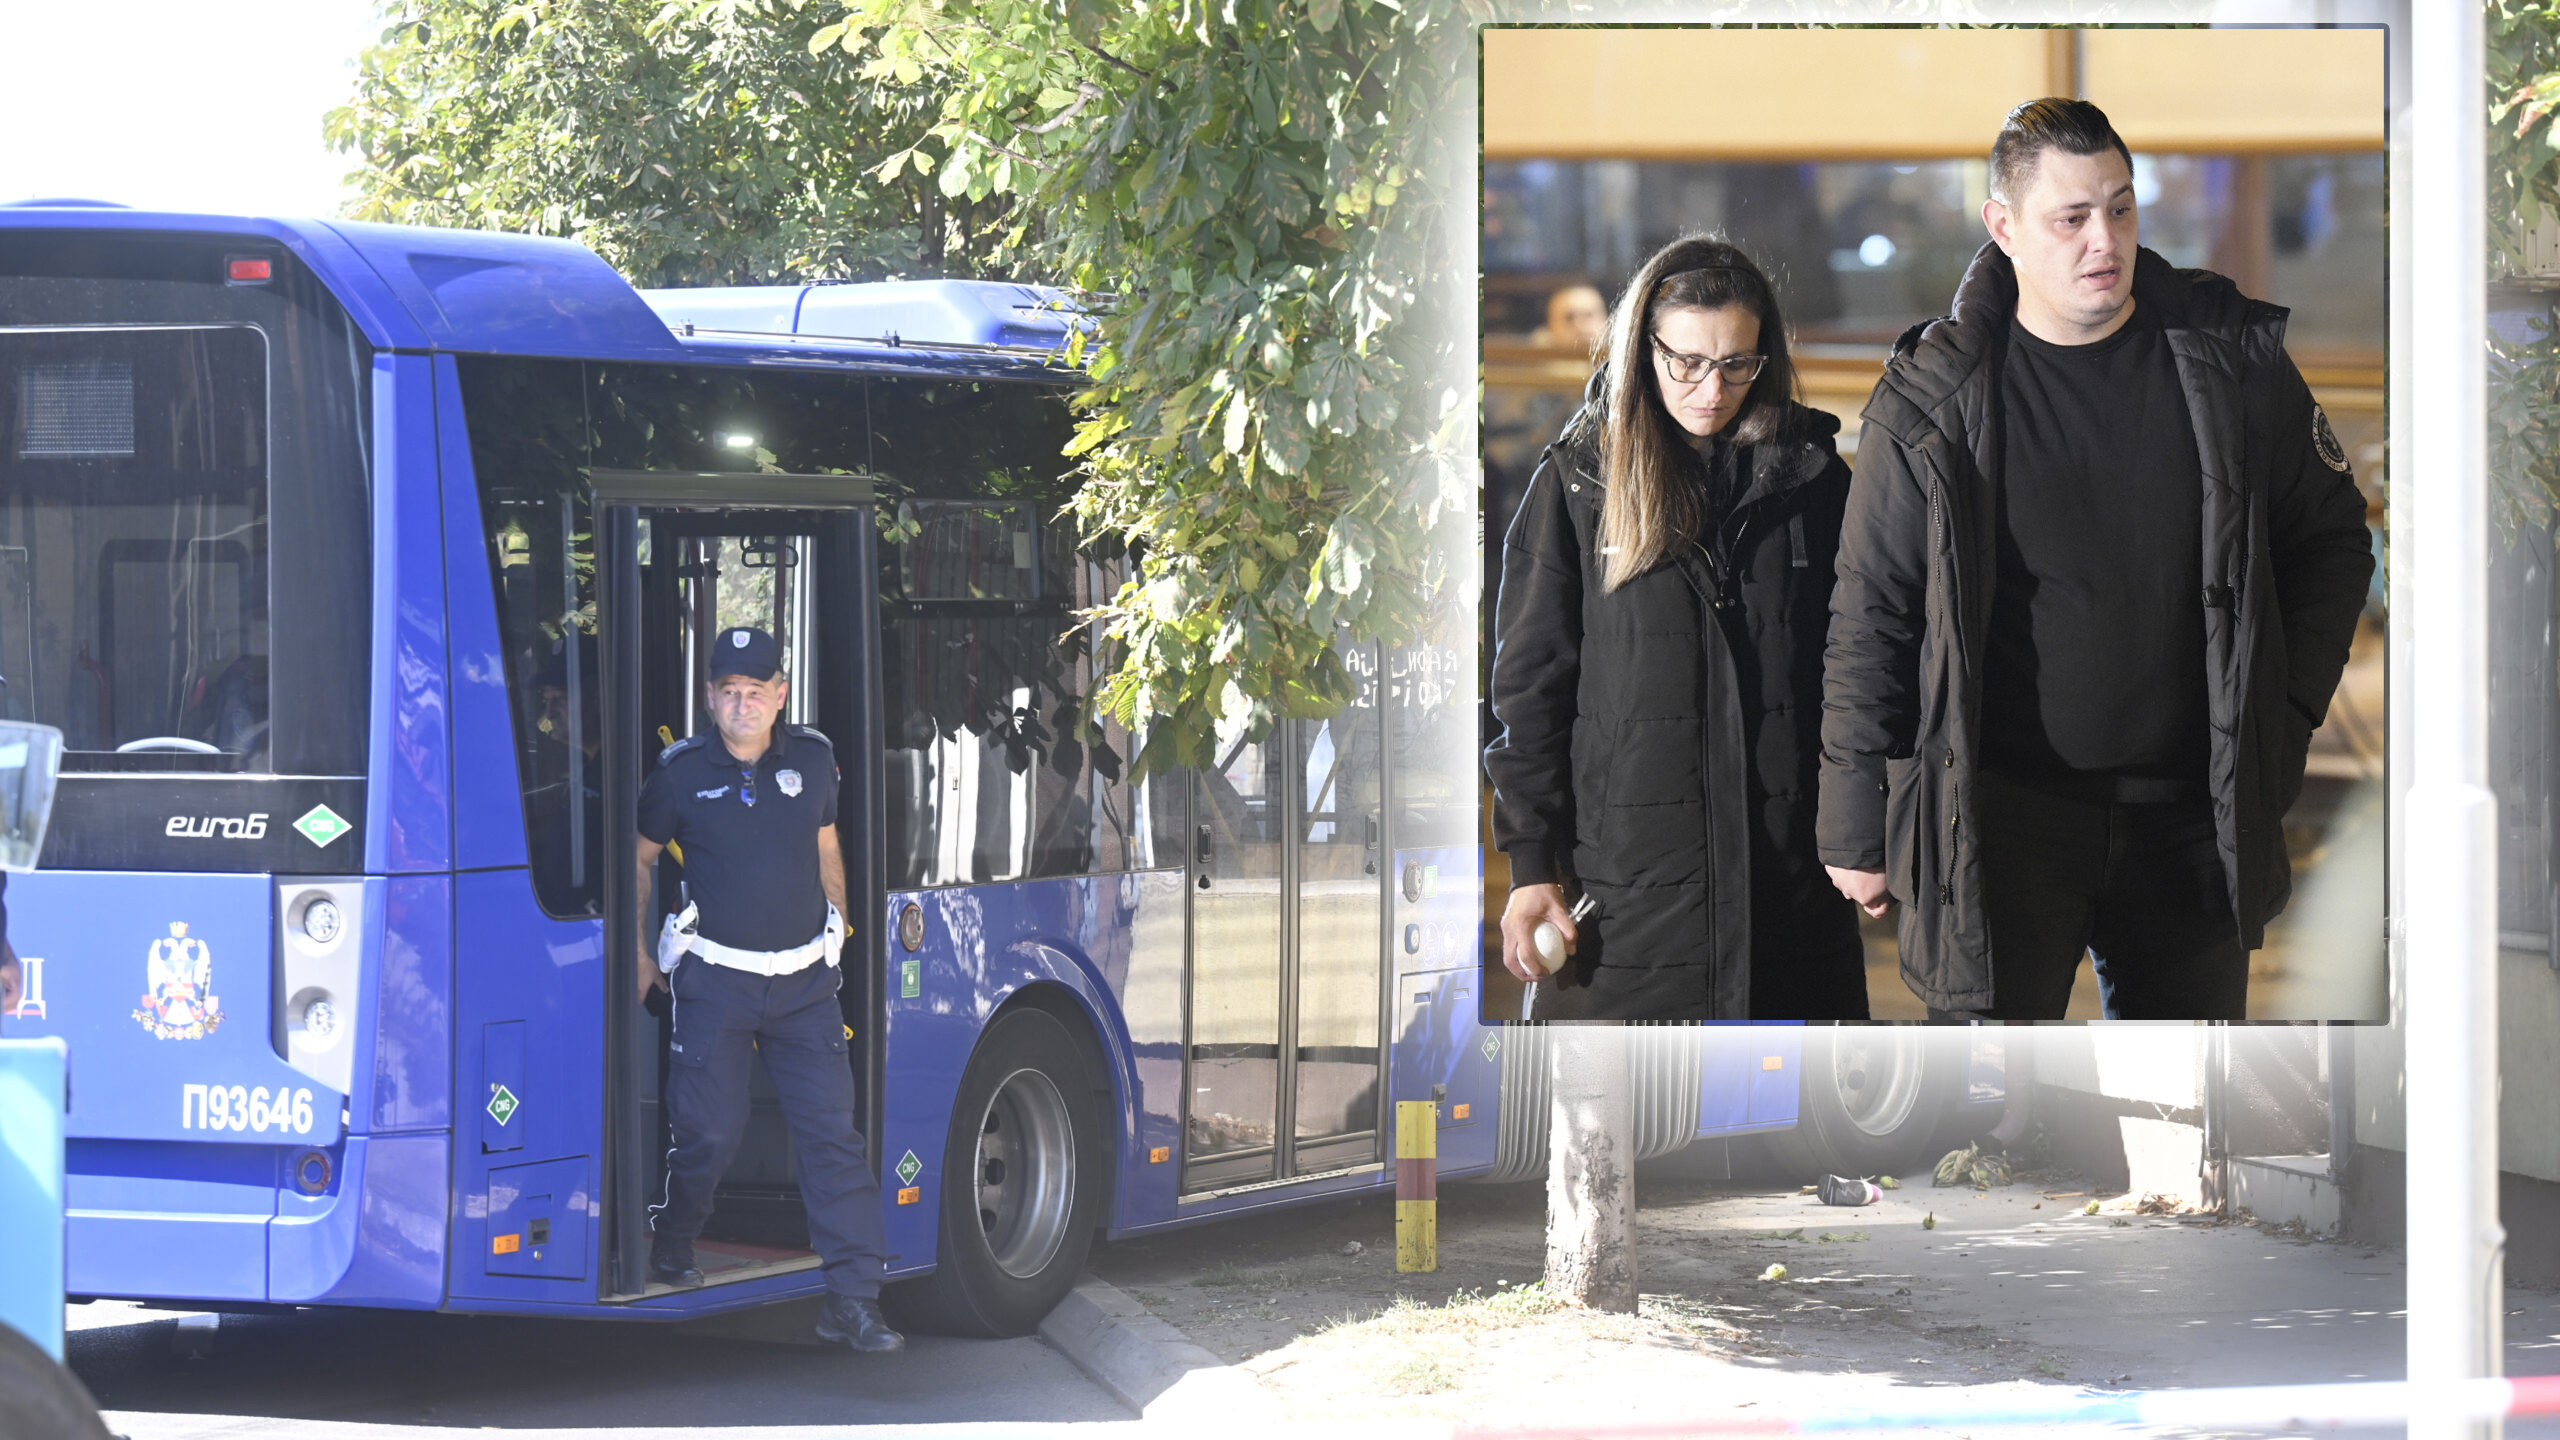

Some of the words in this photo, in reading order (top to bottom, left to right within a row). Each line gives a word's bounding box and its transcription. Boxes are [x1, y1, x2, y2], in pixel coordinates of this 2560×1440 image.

[182, 1083, 314, 1134] П93646
[495, 1098, 510, 1113] CNG
[902, 1161, 915, 1174] CNG
